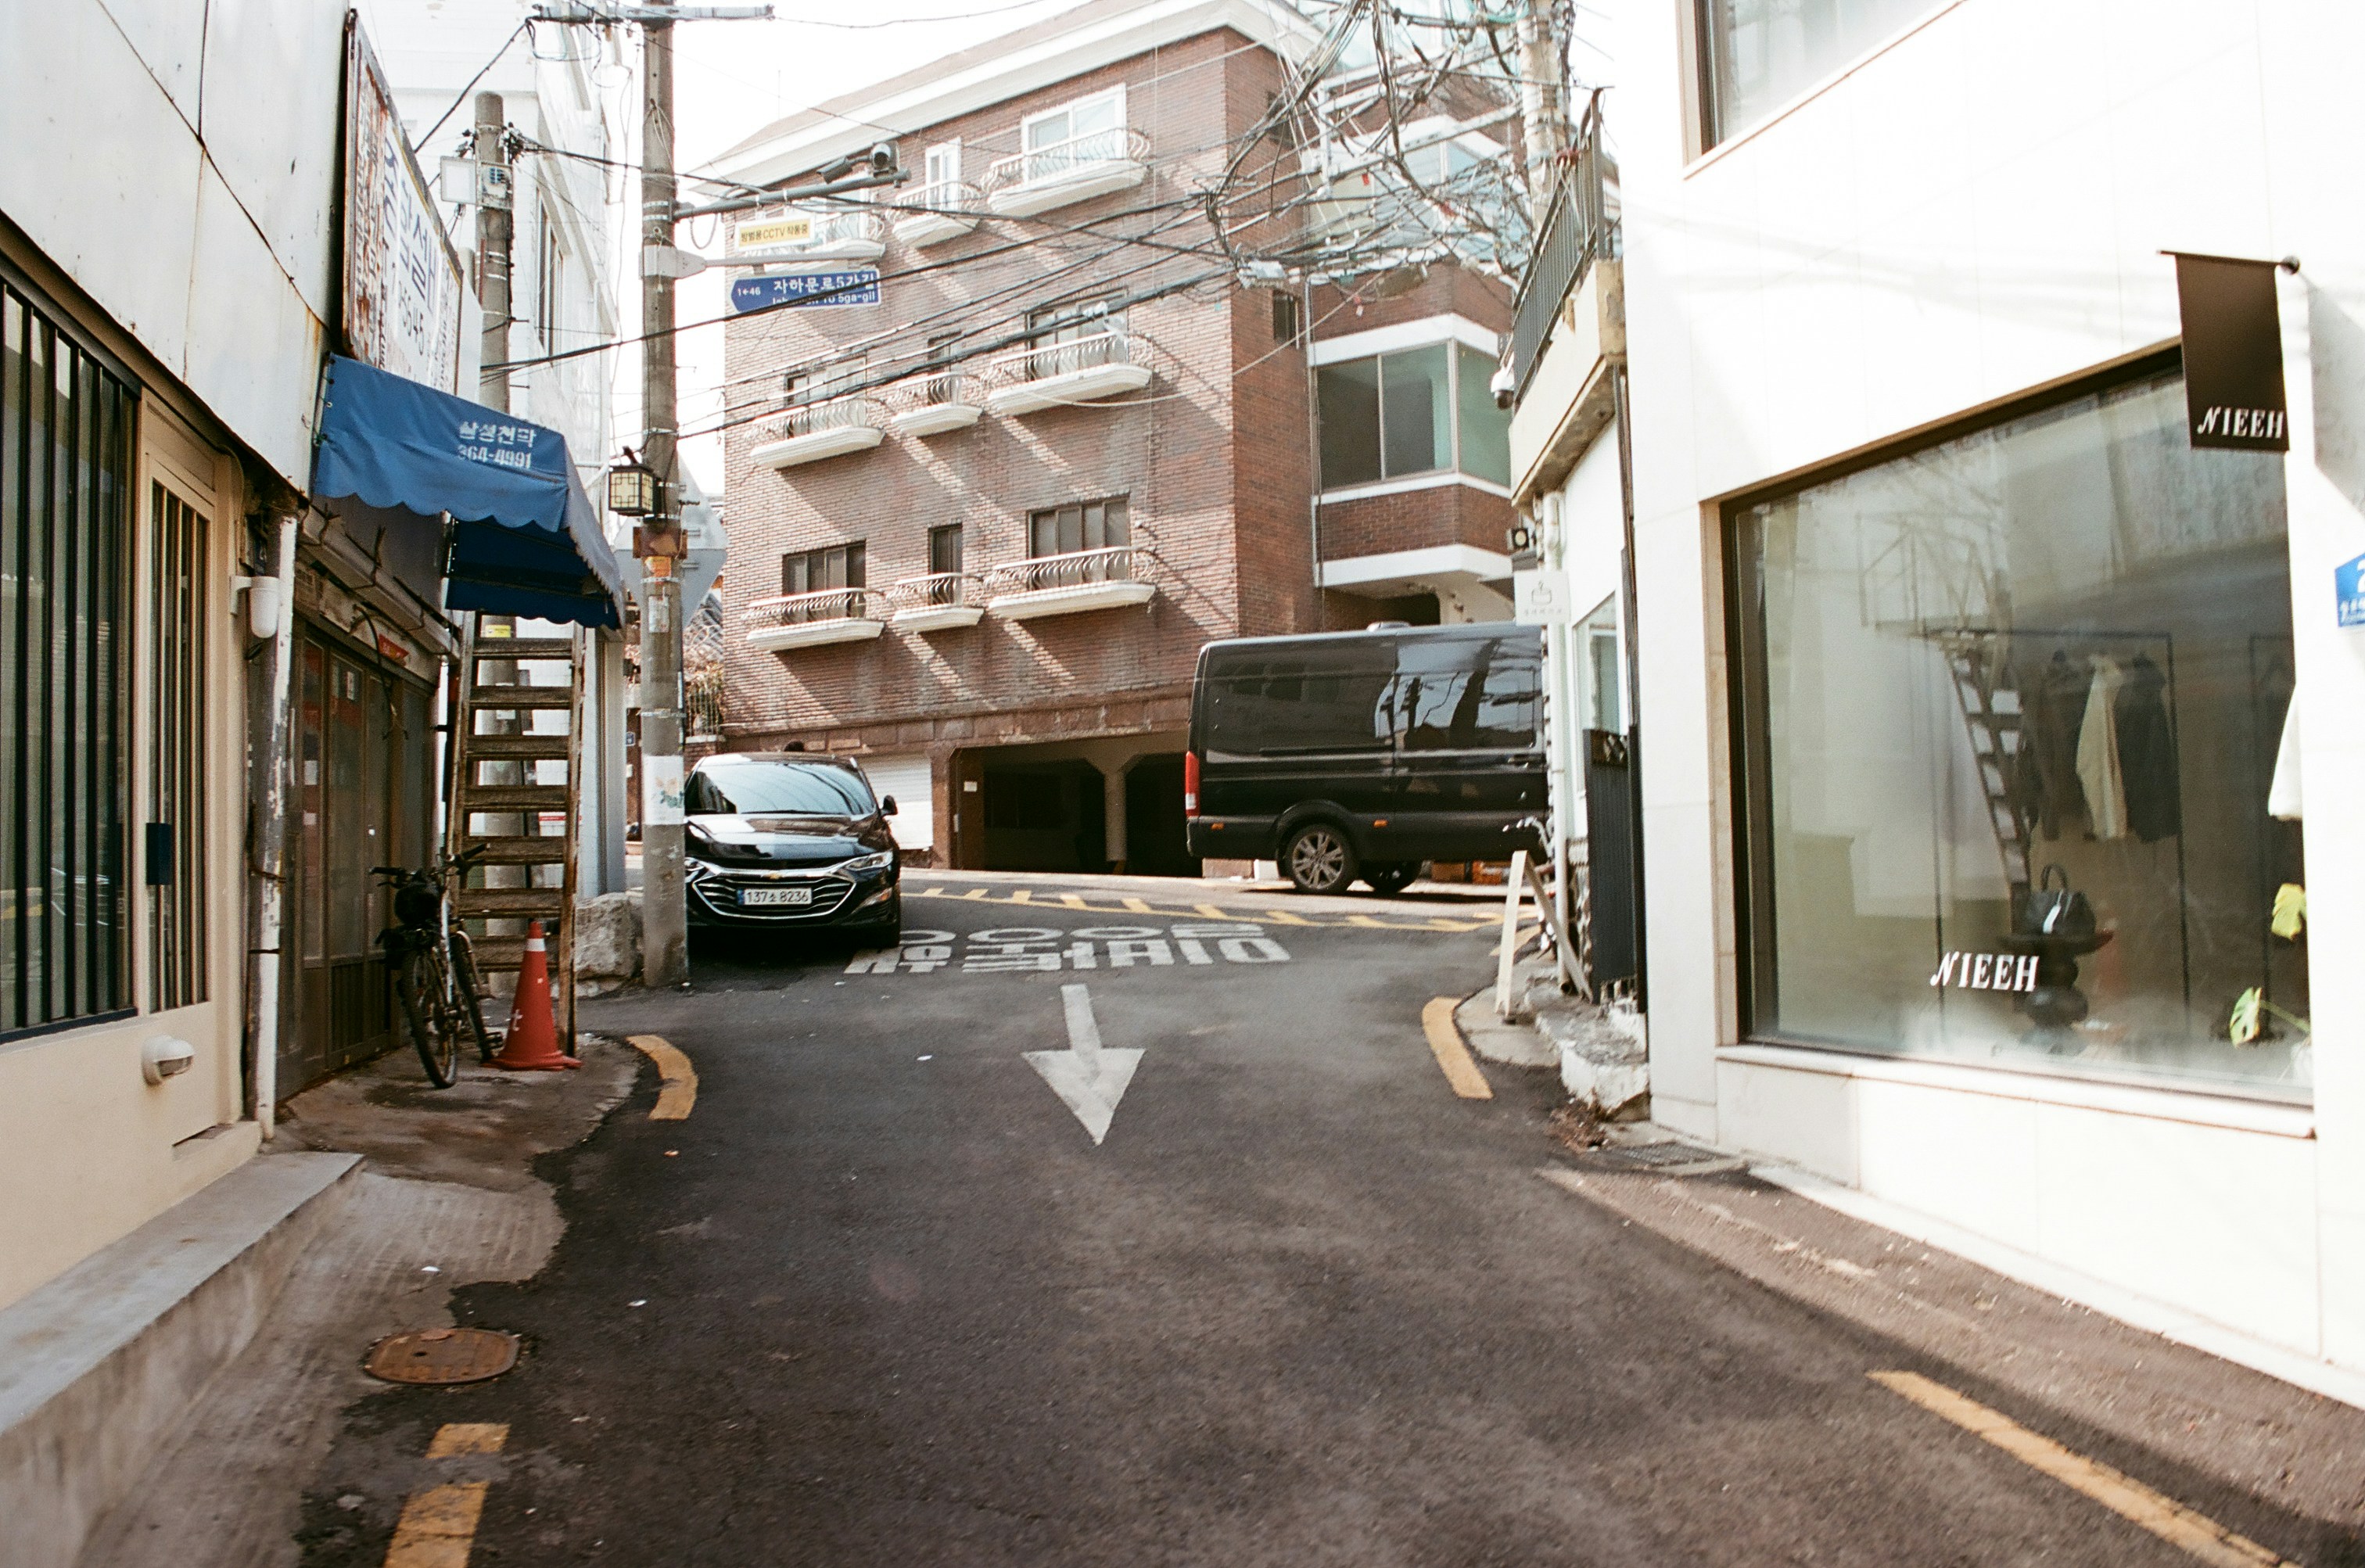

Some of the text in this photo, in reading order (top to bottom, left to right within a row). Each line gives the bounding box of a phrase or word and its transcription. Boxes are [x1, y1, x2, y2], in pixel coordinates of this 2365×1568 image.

[773, 273, 874, 294] 자하문로5가길
[2197, 406, 2284, 439] NIEEH
[1929, 951, 2040, 992] NIEEH
